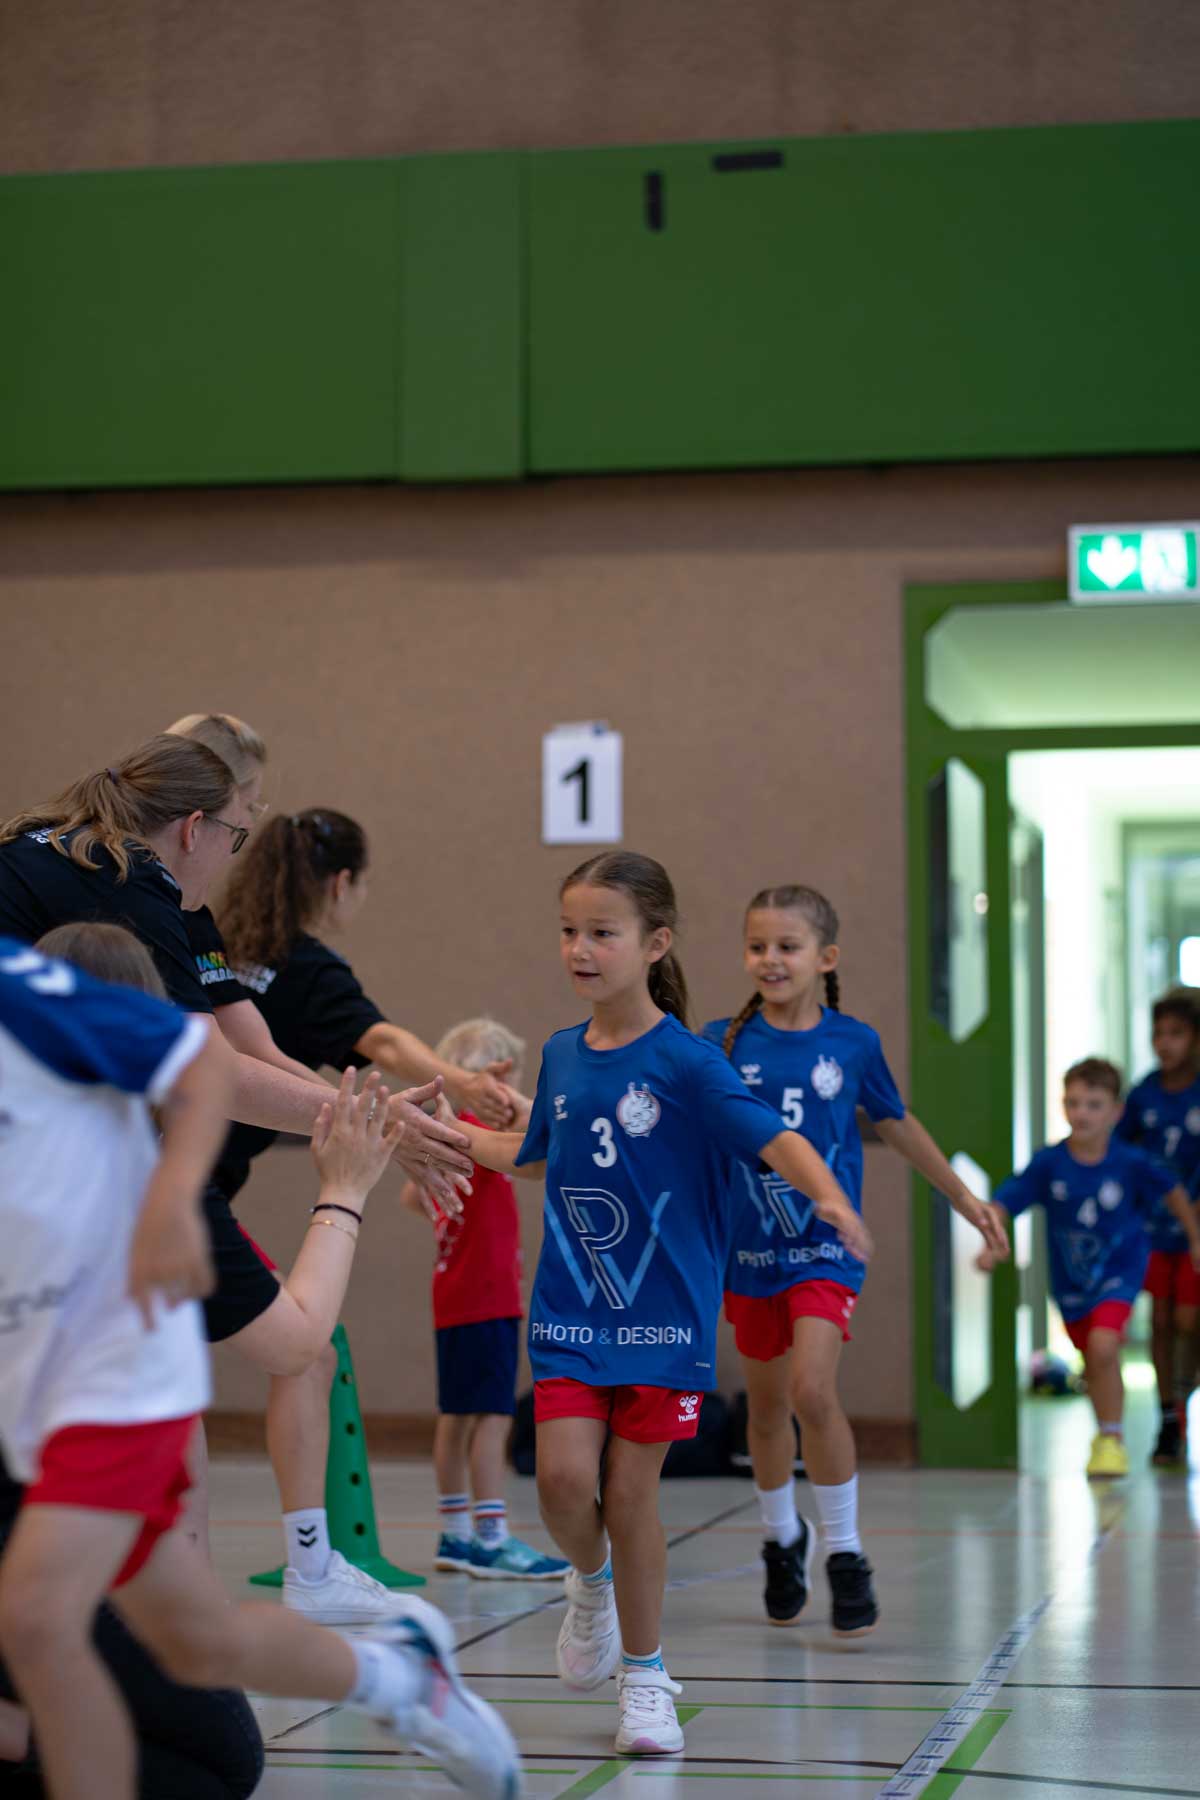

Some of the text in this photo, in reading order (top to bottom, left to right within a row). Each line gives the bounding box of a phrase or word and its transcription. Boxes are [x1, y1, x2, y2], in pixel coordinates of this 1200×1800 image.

[561, 757, 592, 823] 1
[781, 1087, 804, 1130] 5
[590, 1117, 618, 1169] 3
[1076, 1197, 1099, 1228] 4
[532, 1322, 692, 1345] PHOTO & DESIGN
